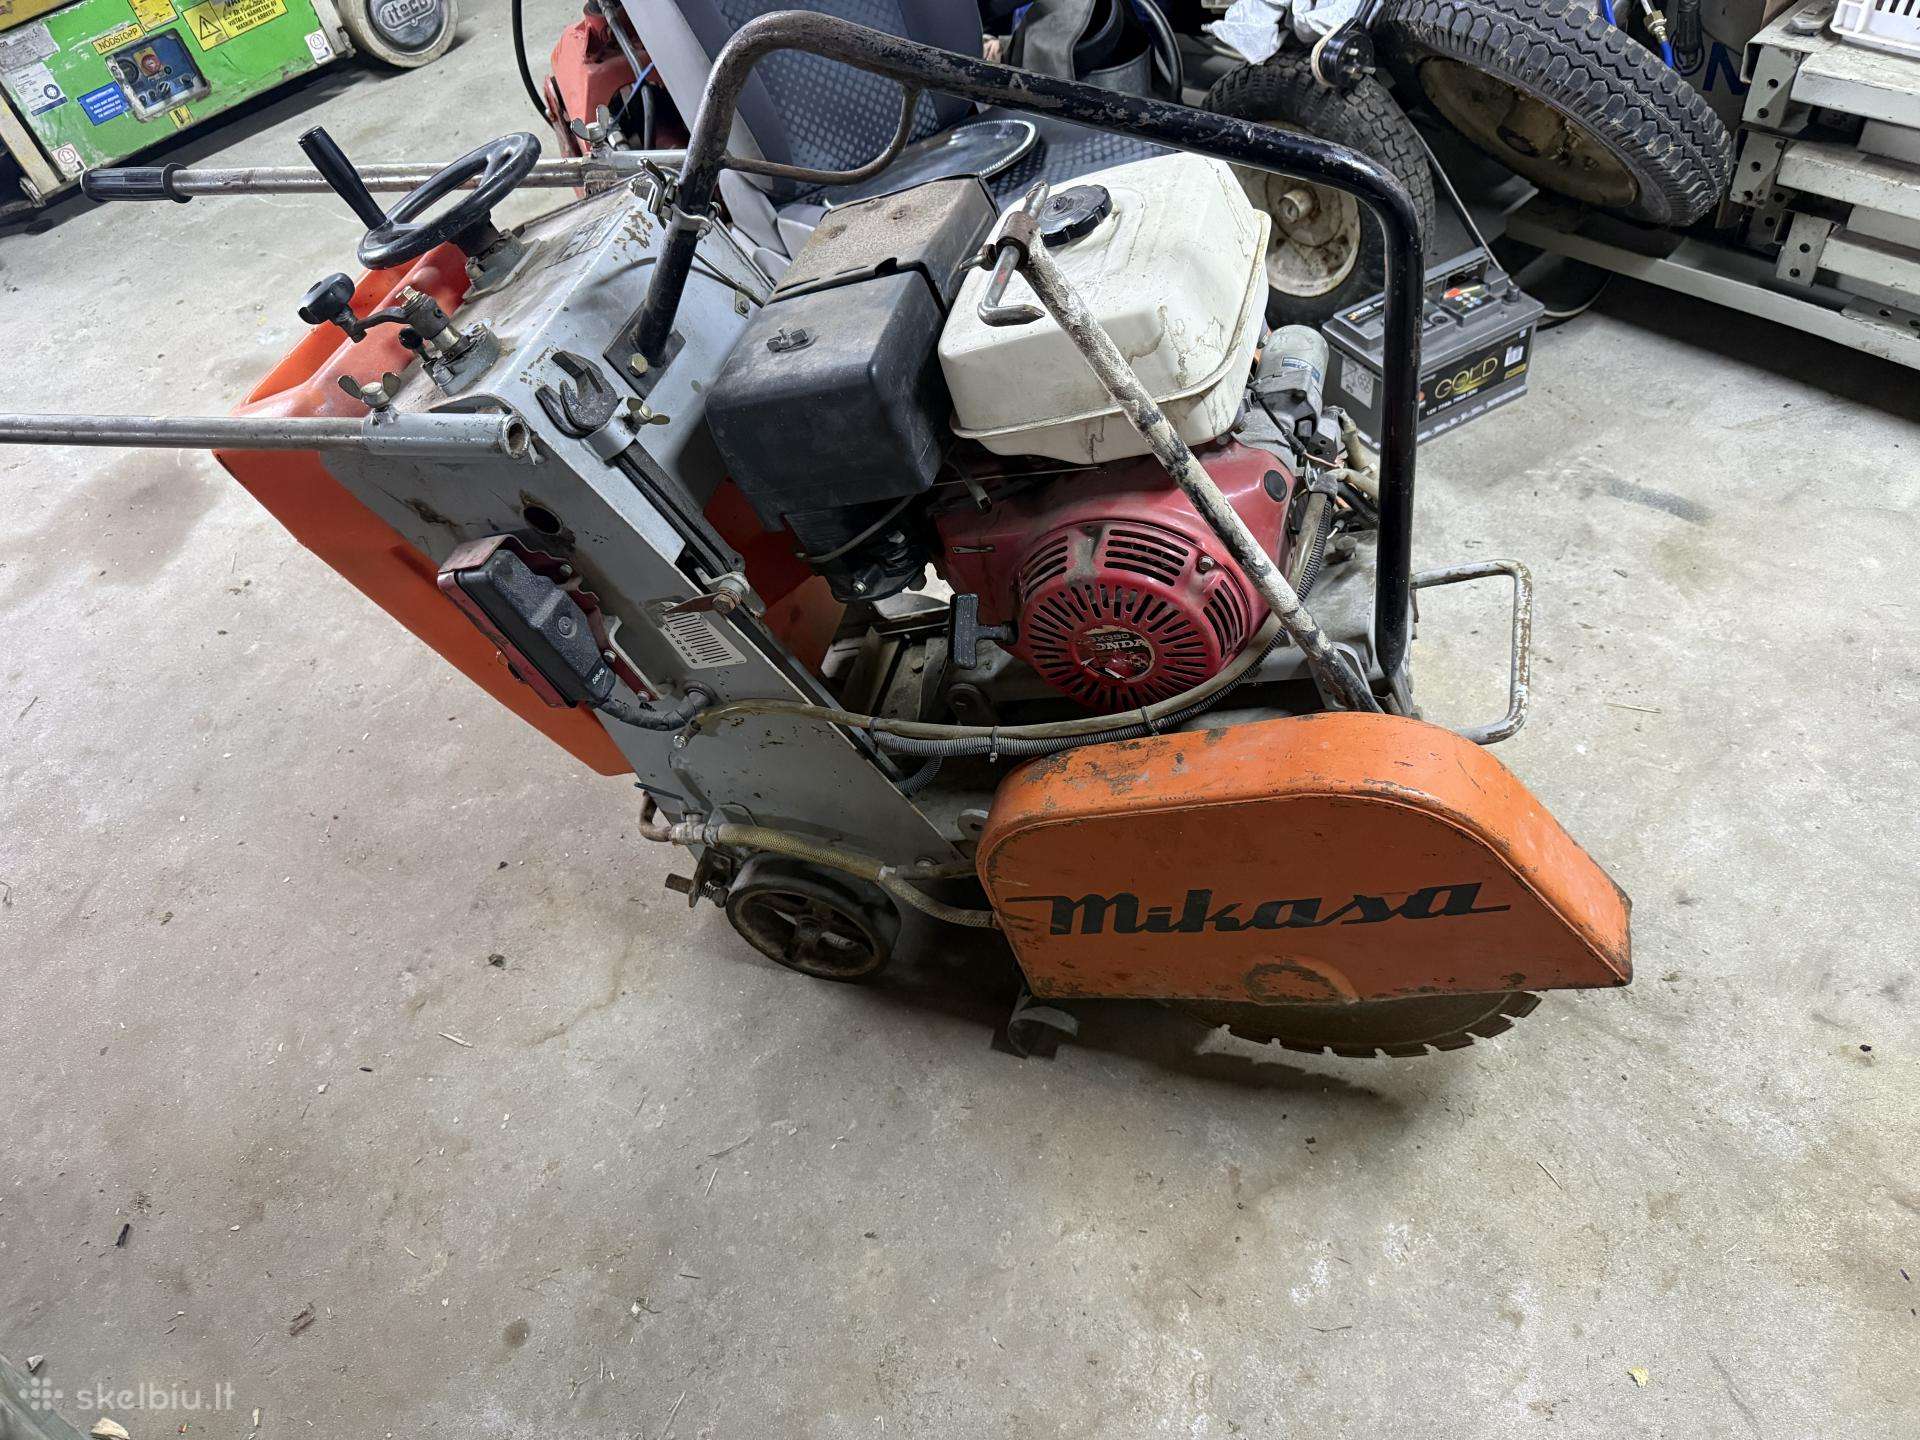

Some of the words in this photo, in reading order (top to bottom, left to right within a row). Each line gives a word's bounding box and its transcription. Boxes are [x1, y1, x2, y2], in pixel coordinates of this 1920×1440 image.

[97, 27, 138, 50] NÖDSTOPP
[1435, 357, 1498, 399] GOLD
[1094, 638, 1147, 651] ONDA
[1004, 882, 1511, 936] Mikasa
